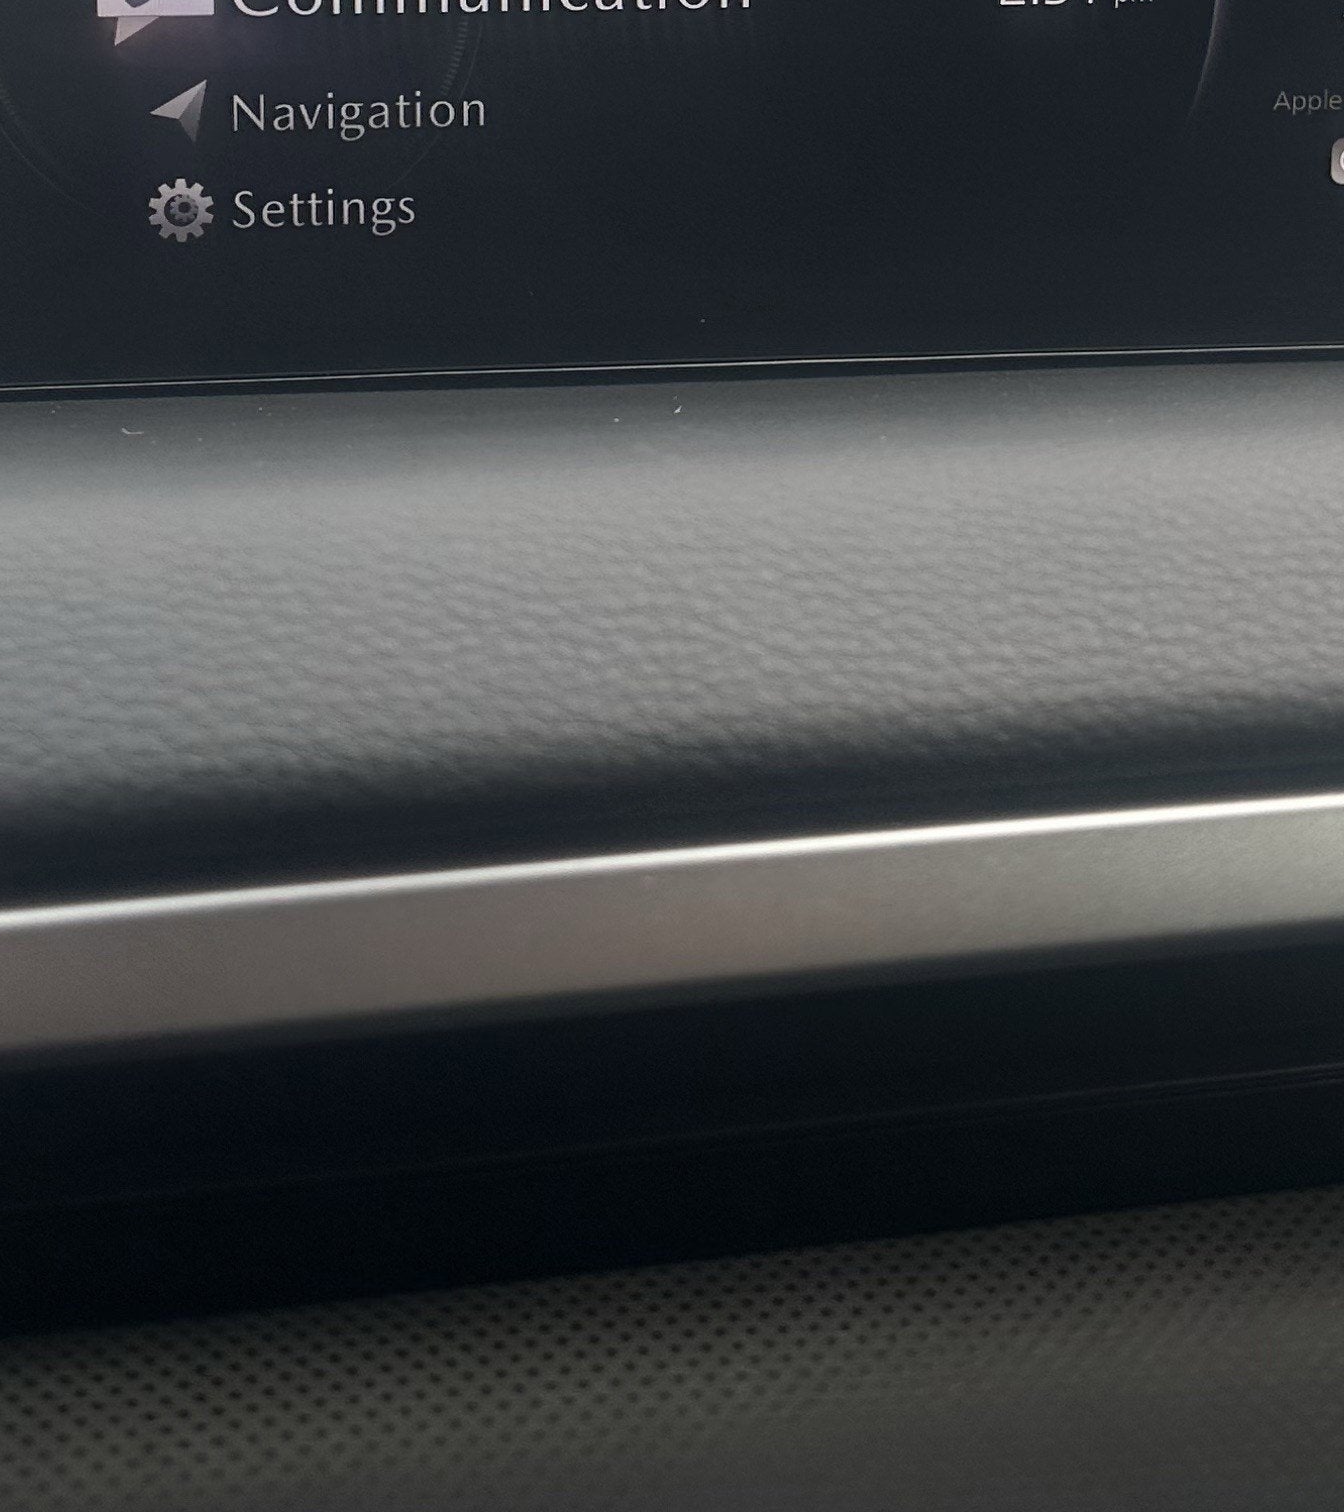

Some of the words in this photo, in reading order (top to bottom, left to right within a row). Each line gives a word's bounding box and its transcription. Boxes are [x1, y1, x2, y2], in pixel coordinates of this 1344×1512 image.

[233, 90, 485, 142] Navigation
[1272, 89, 1343, 116] Apple
[232, 188, 415, 236] Settings
